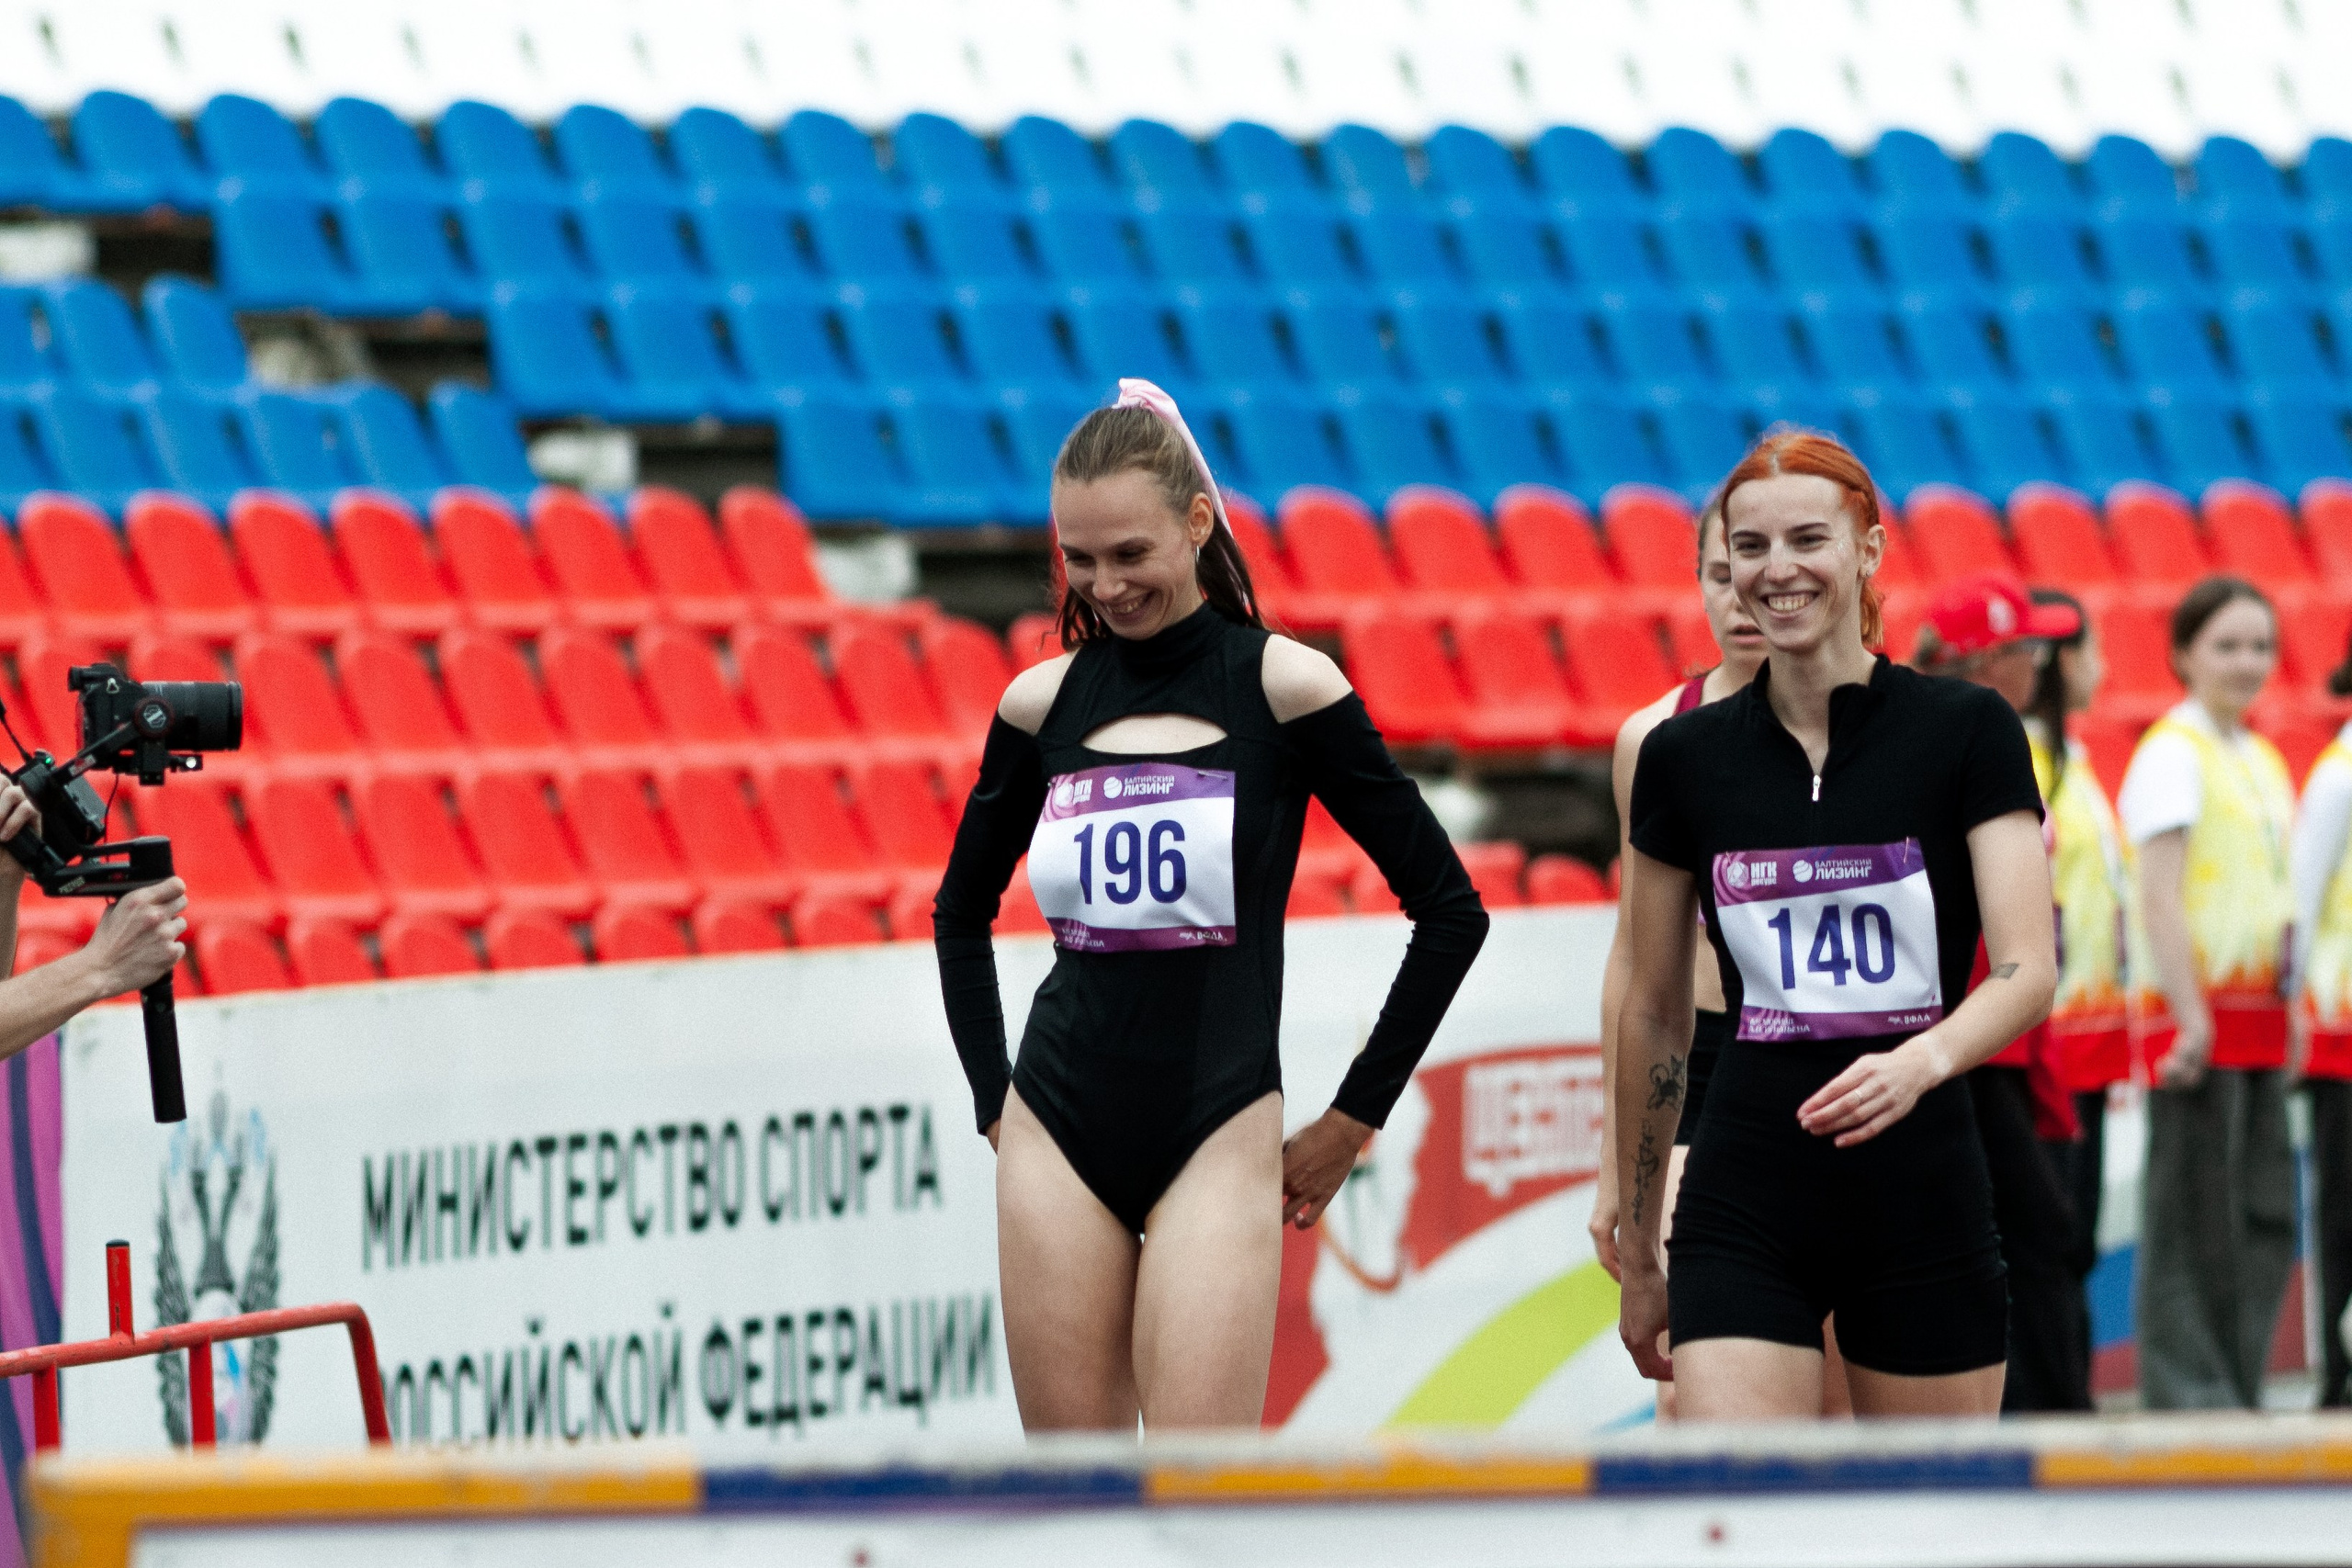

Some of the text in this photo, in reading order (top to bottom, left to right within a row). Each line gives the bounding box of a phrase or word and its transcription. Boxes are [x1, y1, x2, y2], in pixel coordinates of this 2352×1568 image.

[1123, 783, 1174, 797] ЛИЗИНГ
[1073, 819, 1187, 905] 196
[1815, 858, 1872, 868] БАЛТИЙСКИЙ
[1815, 866, 1872, 880] ЛИЗИНГ
[1768, 903, 1895, 990] 140
[362, 1102, 944, 1272] МИНИСТЕРСТВО СПОРТА
[379, 1290, 996, 1446] ОССИЙСКОЙ ФЕДЕРАЦИИ
